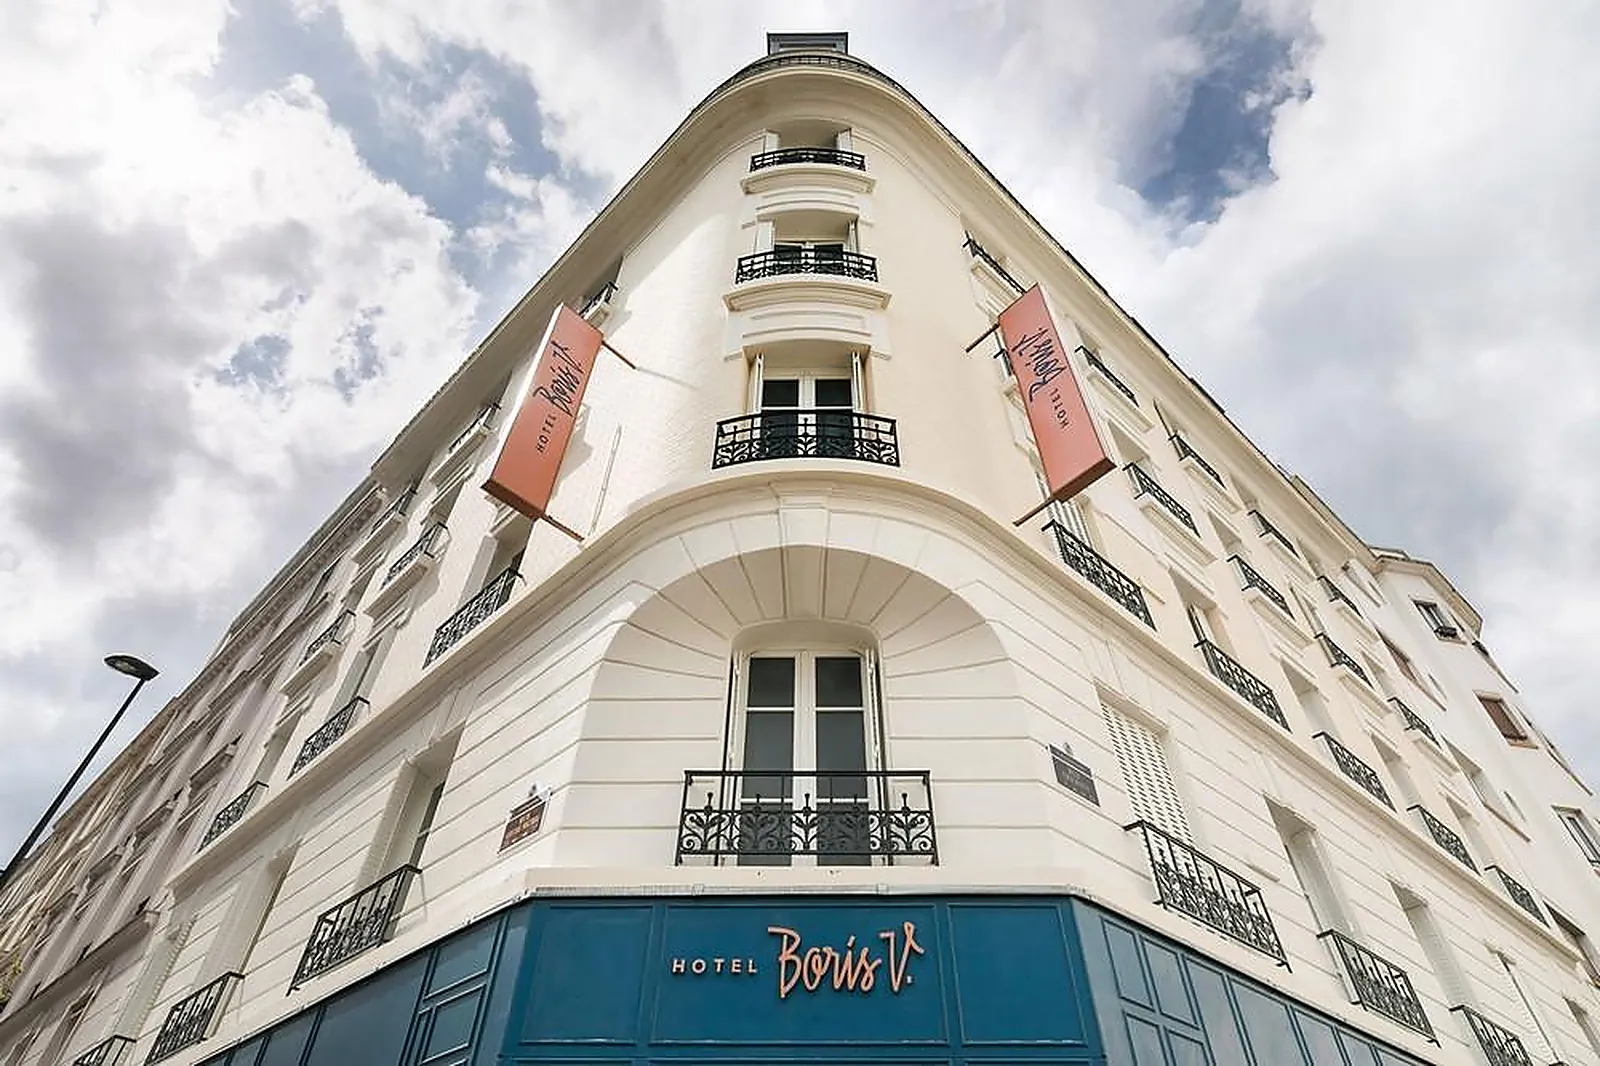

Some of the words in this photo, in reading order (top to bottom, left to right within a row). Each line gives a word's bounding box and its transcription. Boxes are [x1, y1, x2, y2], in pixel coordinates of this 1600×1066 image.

[532, 366, 579, 417] Boris
[1025, 338, 1067, 403] Boris
[535, 414, 557, 453] HOTEL
[1050, 388, 1070, 428] HOTEL
[671, 958, 759, 976] HOTEL
[767, 925, 882, 999] Boris
[879, 921, 925, 992] V.
